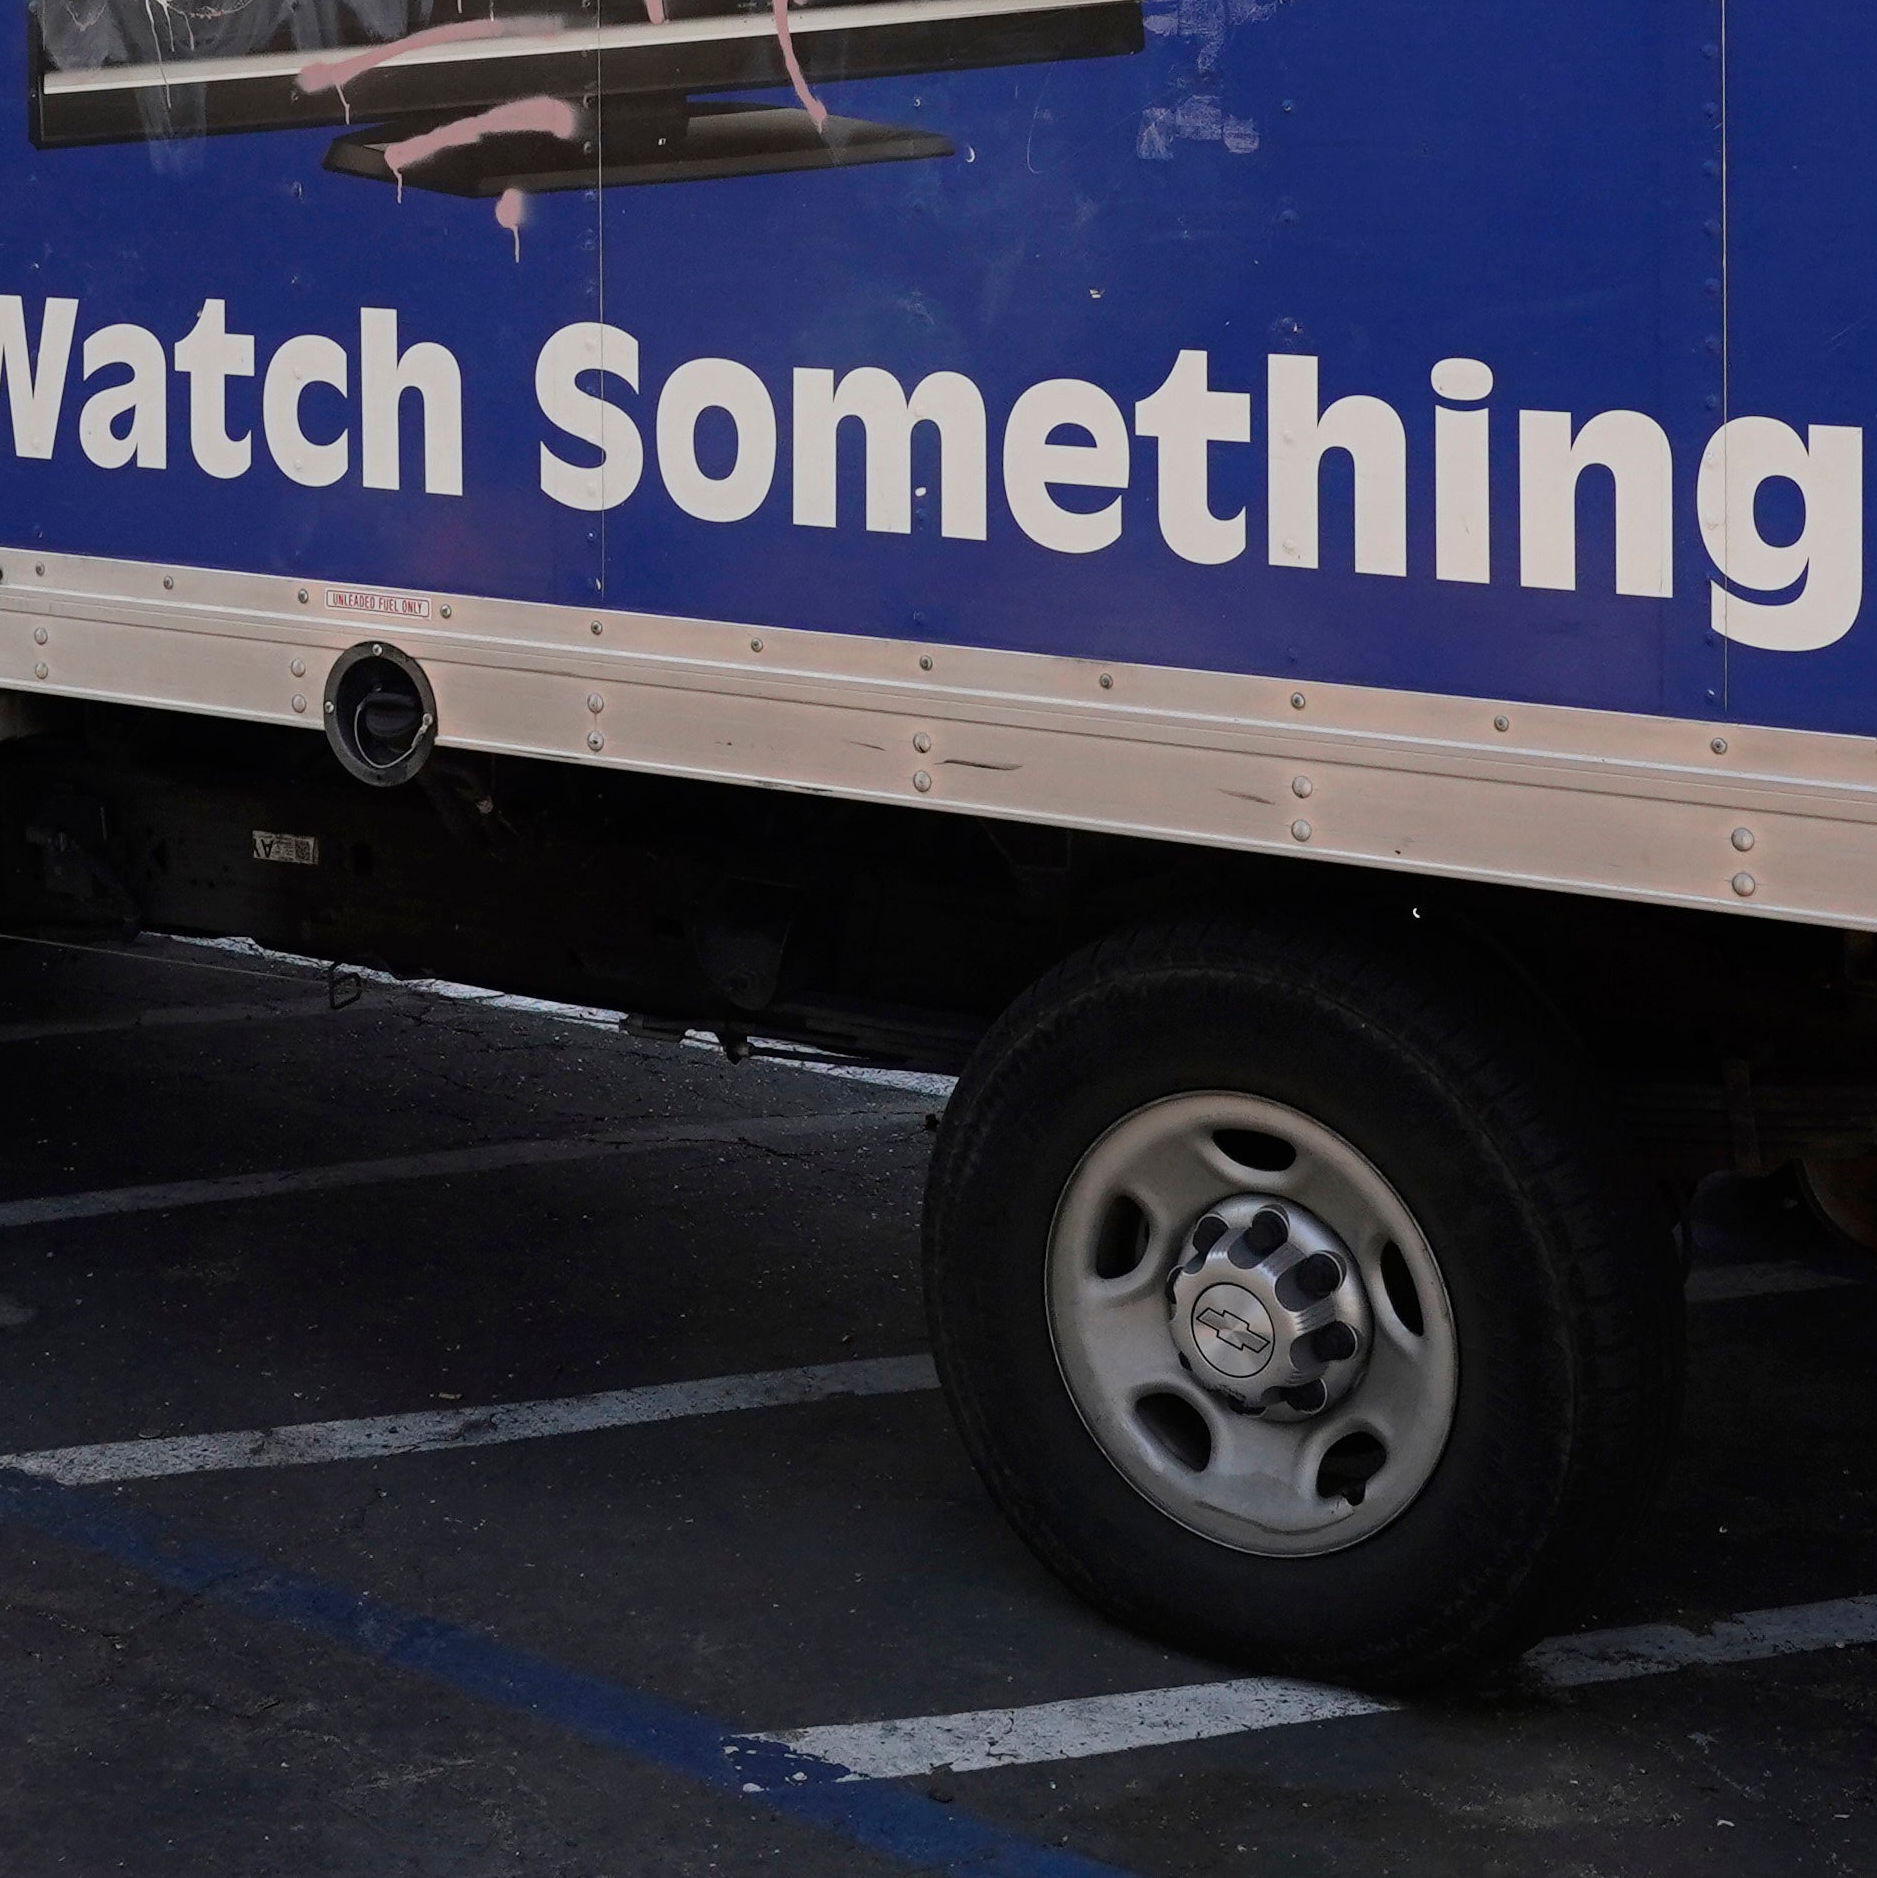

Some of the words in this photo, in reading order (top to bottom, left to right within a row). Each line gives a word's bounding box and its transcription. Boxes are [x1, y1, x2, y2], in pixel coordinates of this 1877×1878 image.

[534, 321, 1863, 653] Something
[333, 593, 375, 609] UNLEADED
[379, 598, 399, 612] FUEL
[402, 600, 422, 614] ONLY
